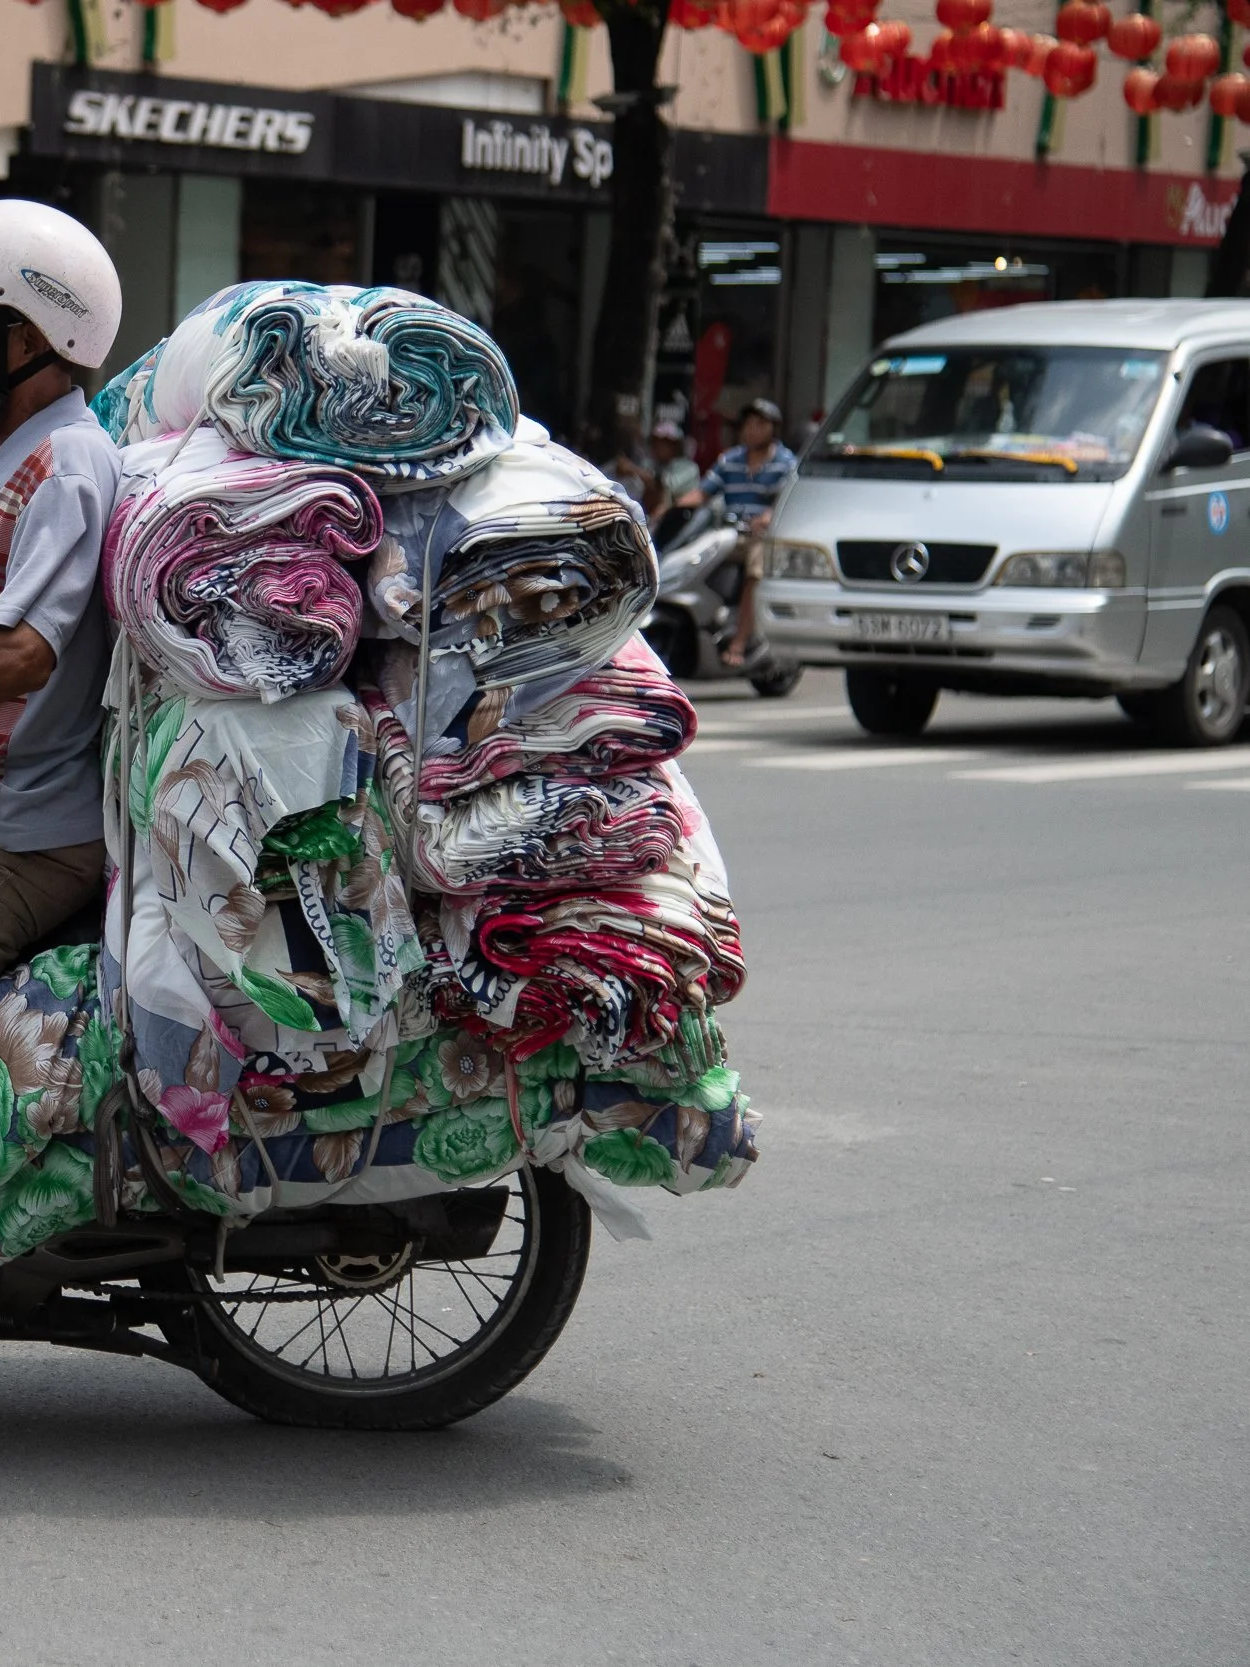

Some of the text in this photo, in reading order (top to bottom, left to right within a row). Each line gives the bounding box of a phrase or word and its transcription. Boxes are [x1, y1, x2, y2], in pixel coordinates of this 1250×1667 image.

[63, 89, 316, 153] SKECHERS
[461, 118, 569, 187] Infinity
[29, 272, 89, 319] SuperSport
